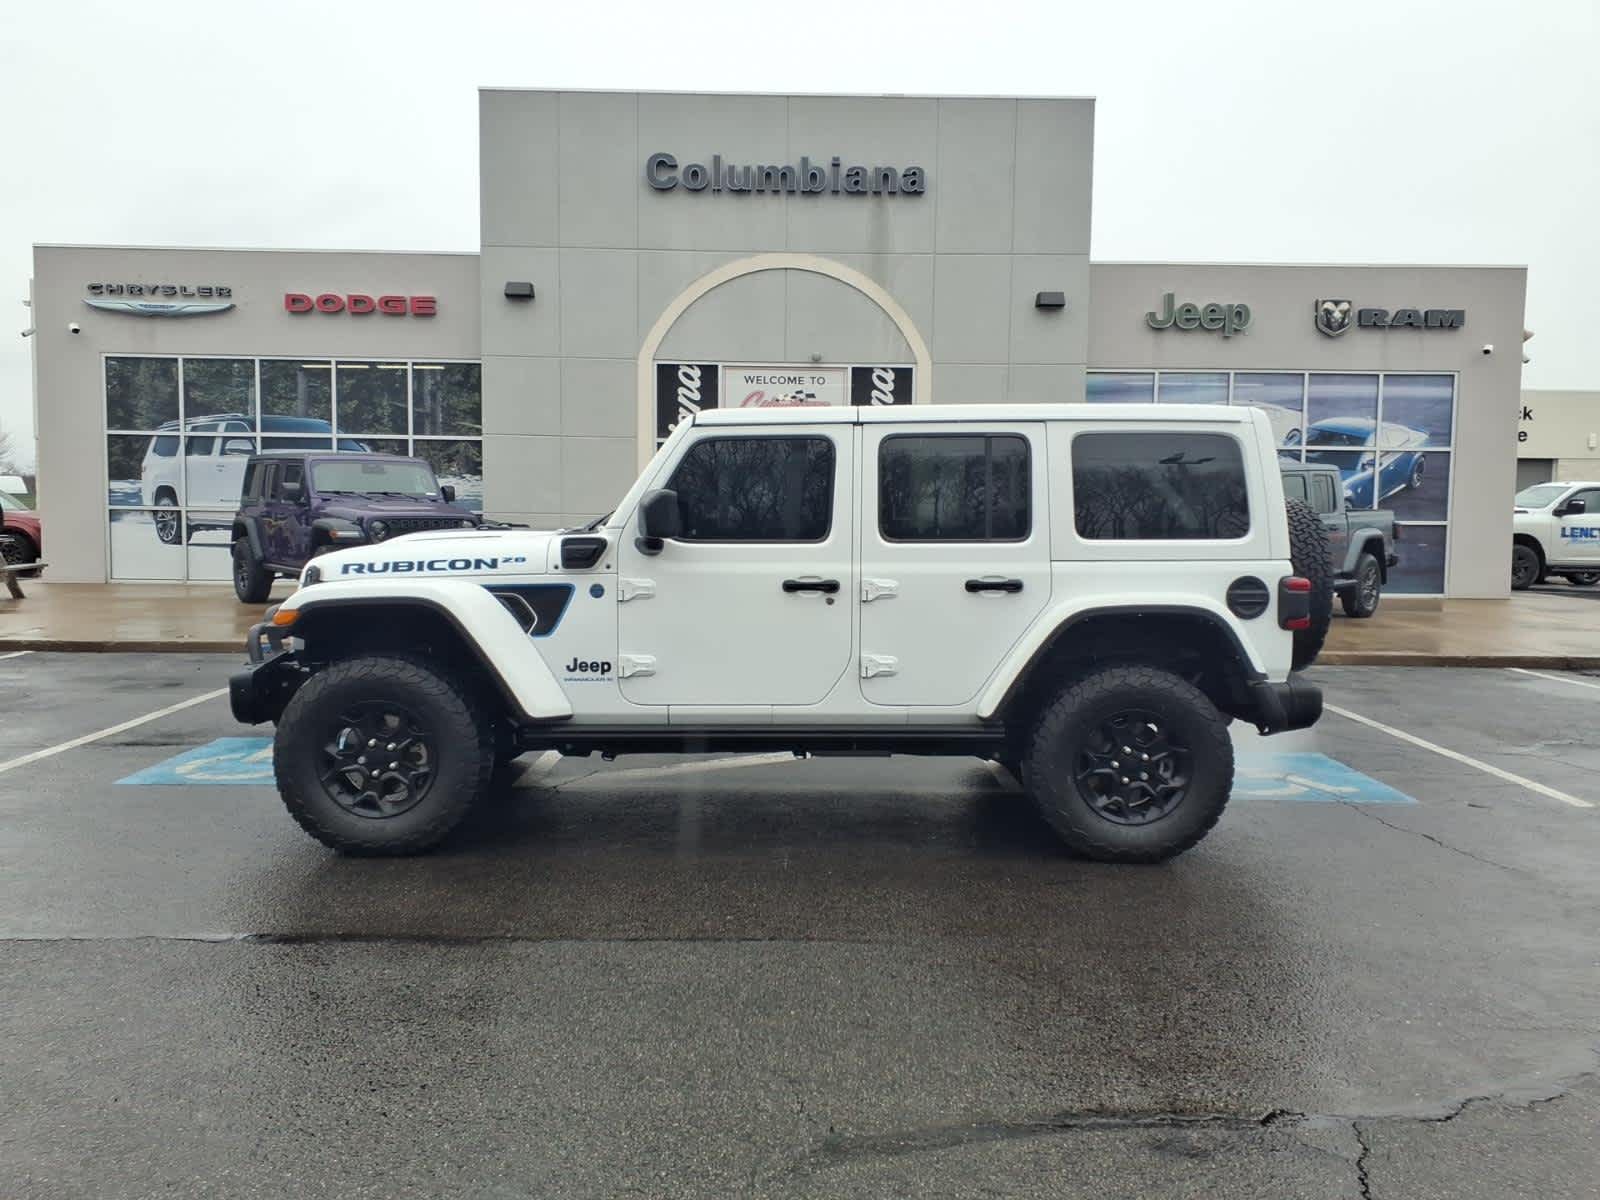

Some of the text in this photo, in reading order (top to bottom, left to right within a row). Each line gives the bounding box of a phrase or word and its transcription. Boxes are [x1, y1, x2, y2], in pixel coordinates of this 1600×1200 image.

[646, 152, 925, 194] Columbiana
[87, 283, 233, 297] CHRYSLER
[284, 293, 437, 316] DODGE
[1146, 292, 1250, 337] Jeep
[1357, 308, 1465, 328] RAM
[743, 375, 826, 386] WELCOME TO
[341, 558, 498, 575] RUBICON
[566, 656, 611, 675] Jeep
